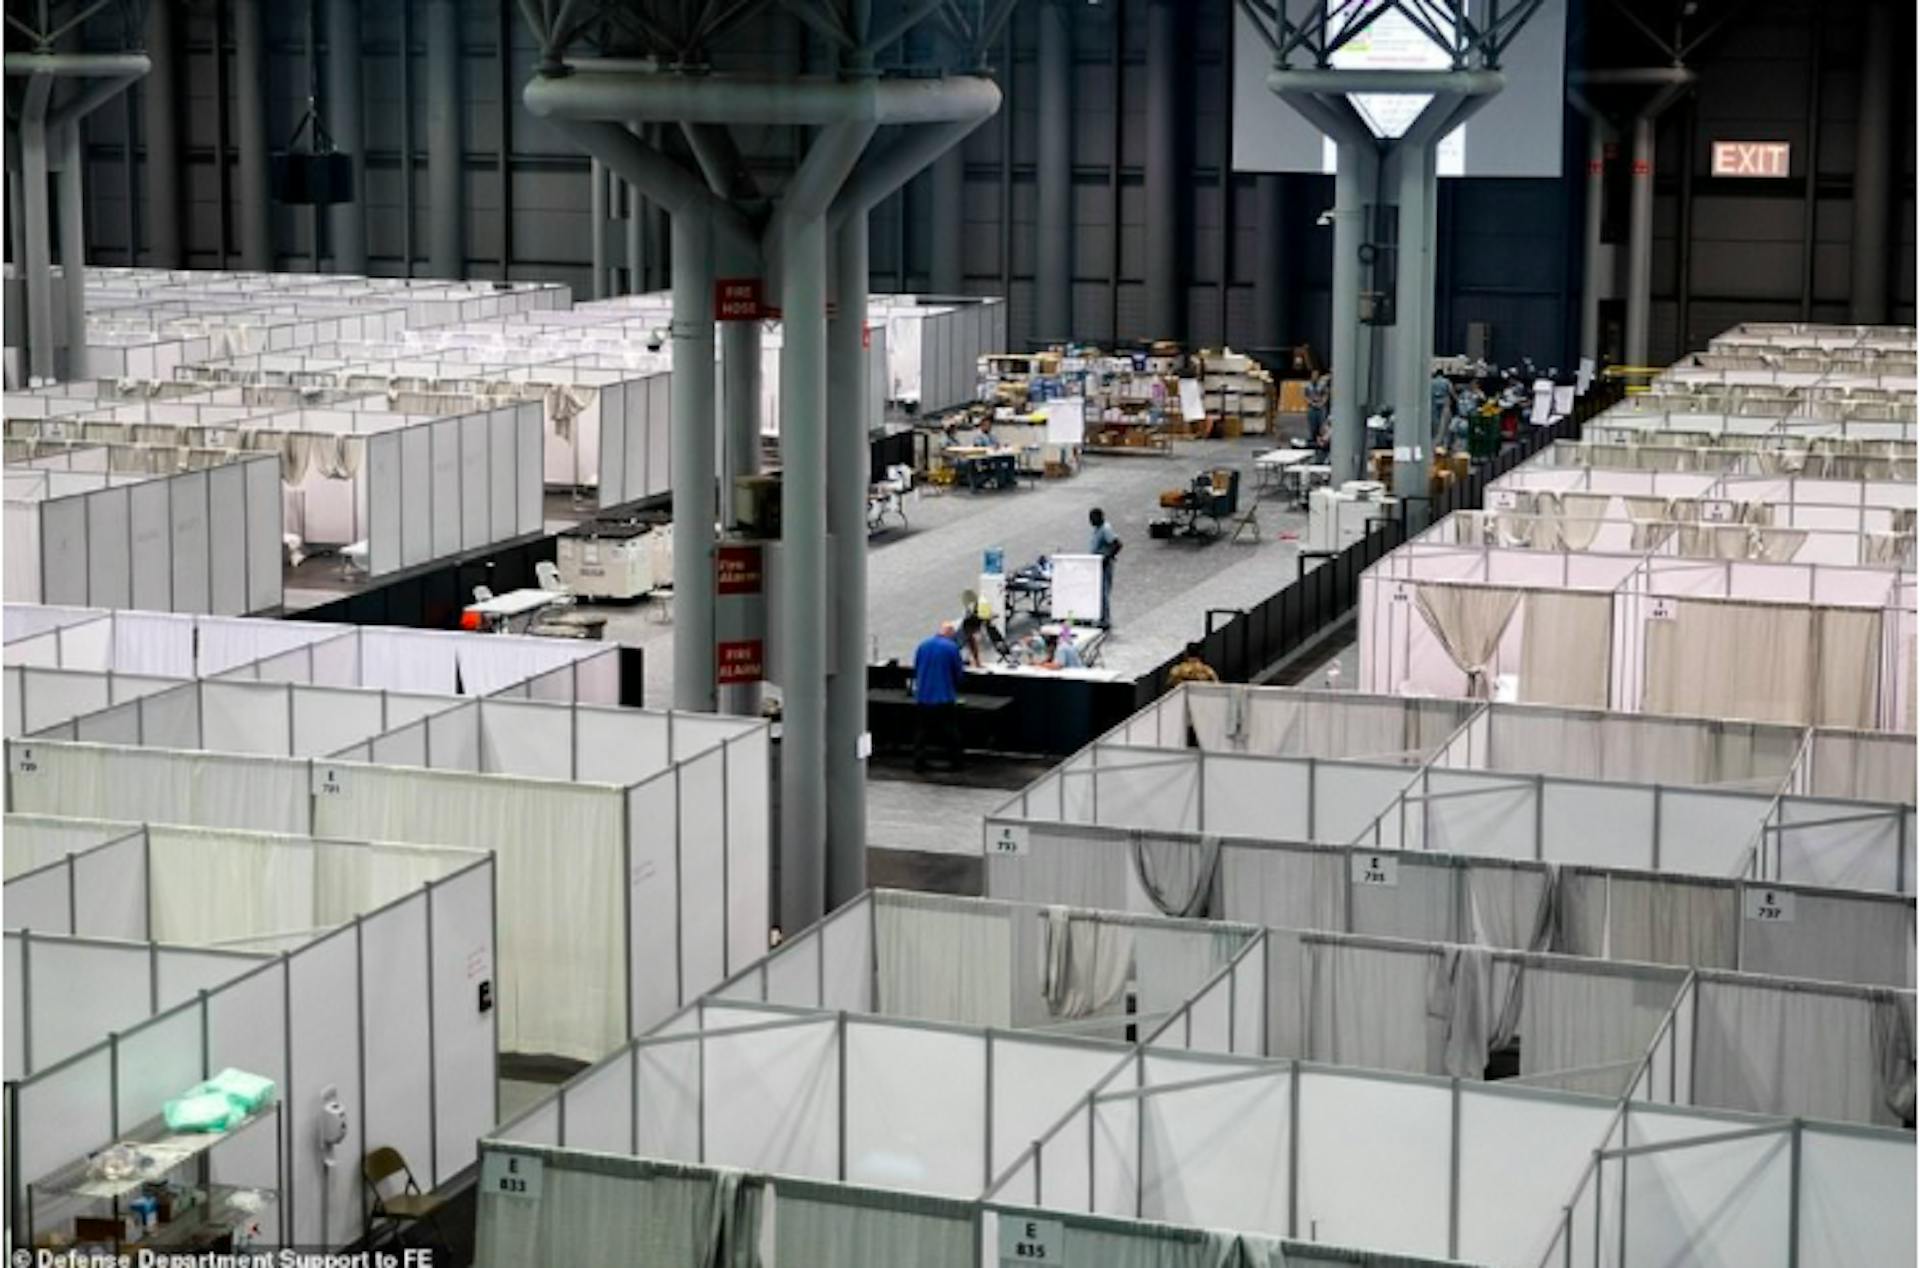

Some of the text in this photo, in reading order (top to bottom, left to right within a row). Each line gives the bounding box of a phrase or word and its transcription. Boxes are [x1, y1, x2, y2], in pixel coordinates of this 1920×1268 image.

[1715, 143, 1786, 173] EXIT
[725, 286, 752, 298] FIRE
[722, 302, 756, 315] HOSE
[725, 648, 751, 660] FIRE
[719, 664, 760, 677] ALARM
[1004, 828, 1010, 839] E
[1371, 857, 1379, 868] E
[1766, 892, 1775, 905] E
[1760, 907, 1781, 918] 737
[509, 1158, 519, 1174] E
[500, 1178, 526, 1192] 833
[1025, 1222, 1037, 1239] E
[1016, 1242, 1046, 1258] 835
